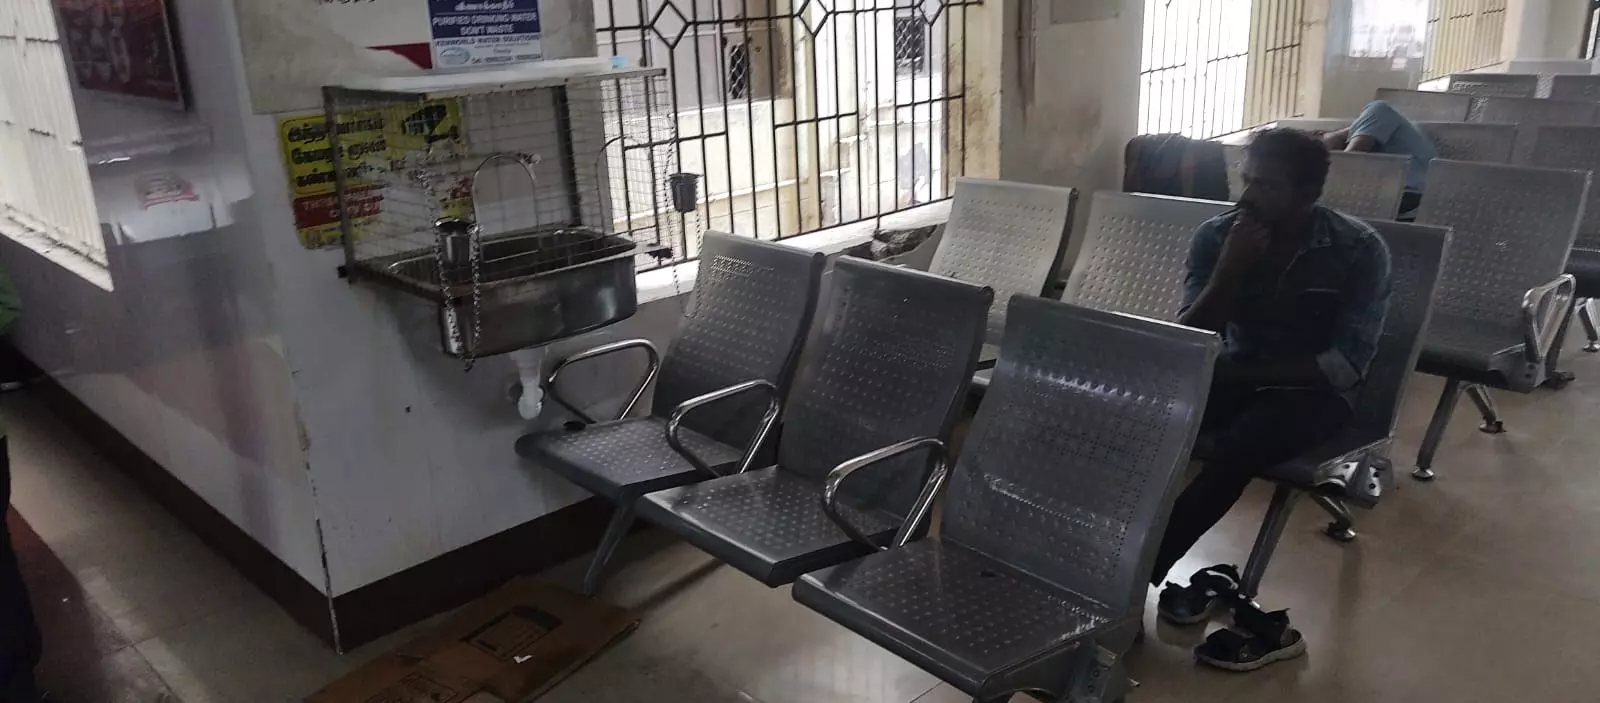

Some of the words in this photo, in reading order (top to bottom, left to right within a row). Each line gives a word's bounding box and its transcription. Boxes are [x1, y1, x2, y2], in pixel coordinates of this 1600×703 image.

[432, 15, 470, 26] PURIFIED
[471, 14, 509, 24] DRINKING
[510, 12, 537, 22] WATER
[486, 24, 514, 34] WASTE
